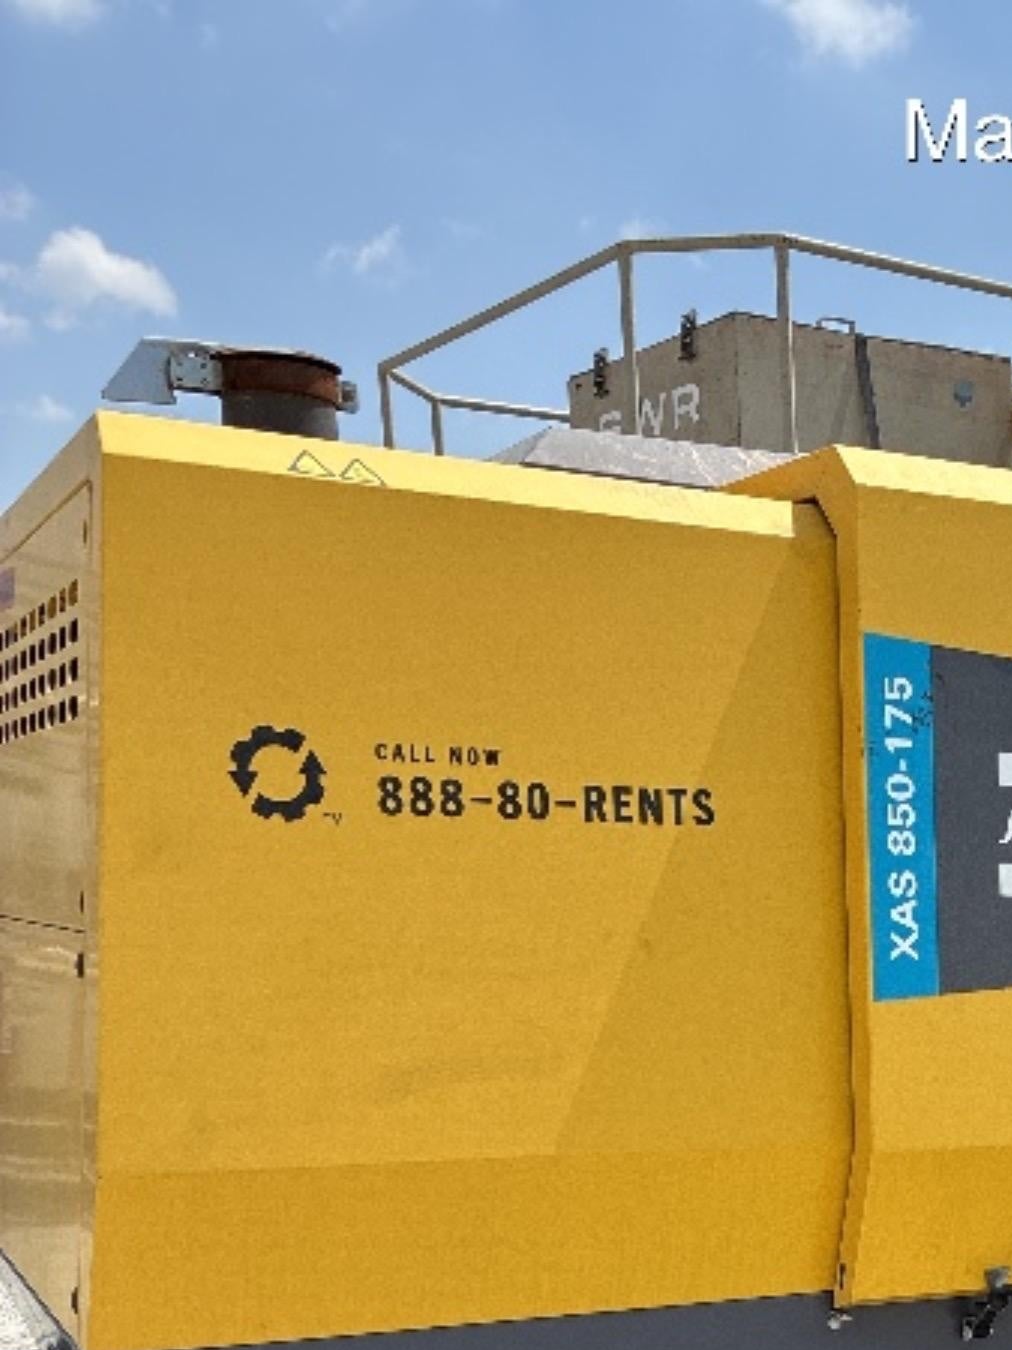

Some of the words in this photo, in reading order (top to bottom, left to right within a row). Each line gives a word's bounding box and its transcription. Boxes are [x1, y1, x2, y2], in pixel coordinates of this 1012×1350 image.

[374, 743, 436, 763] CALL
[448, 746, 502, 767] NOW
[884, 675, 916, 857] 850-175
[377, 775, 716, 827] 888-80-RENTS
[890, 869, 919, 961] XAS
